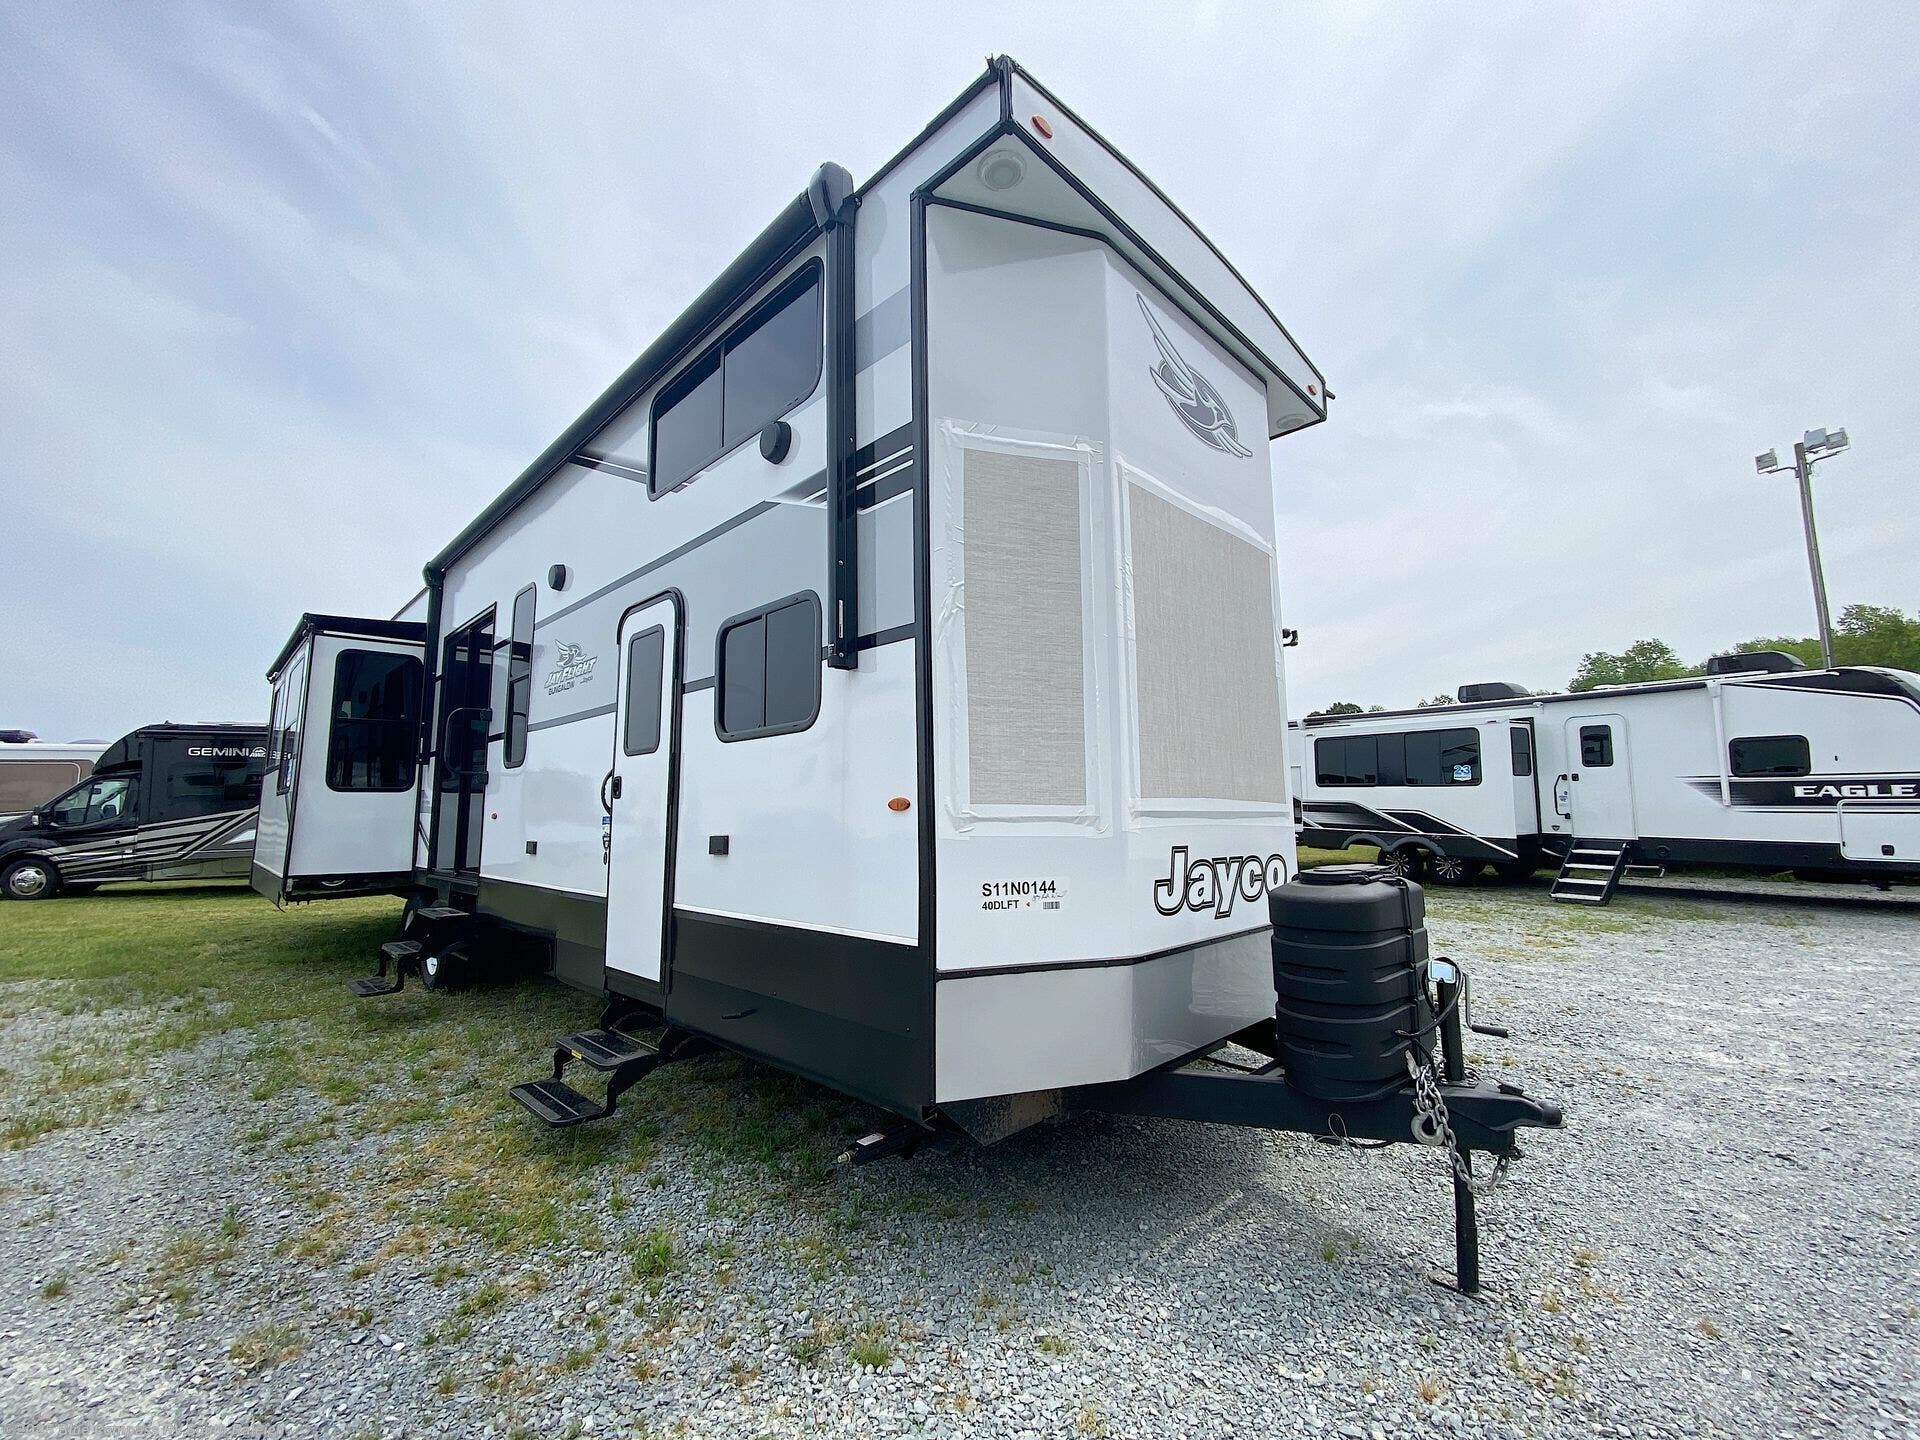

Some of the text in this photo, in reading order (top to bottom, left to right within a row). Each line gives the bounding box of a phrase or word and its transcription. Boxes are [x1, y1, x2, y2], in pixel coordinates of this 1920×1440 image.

[188, 747, 249, 756] GEMINI
[1454, 765, 1471, 775] 23
[1793, 784, 1918, 797] EAGLE
[1154, 845, 1287, 919] Jayco
[981, 880, 1056, 897] S11N0144
[981, 899, 1020, 910] 40DLFT
